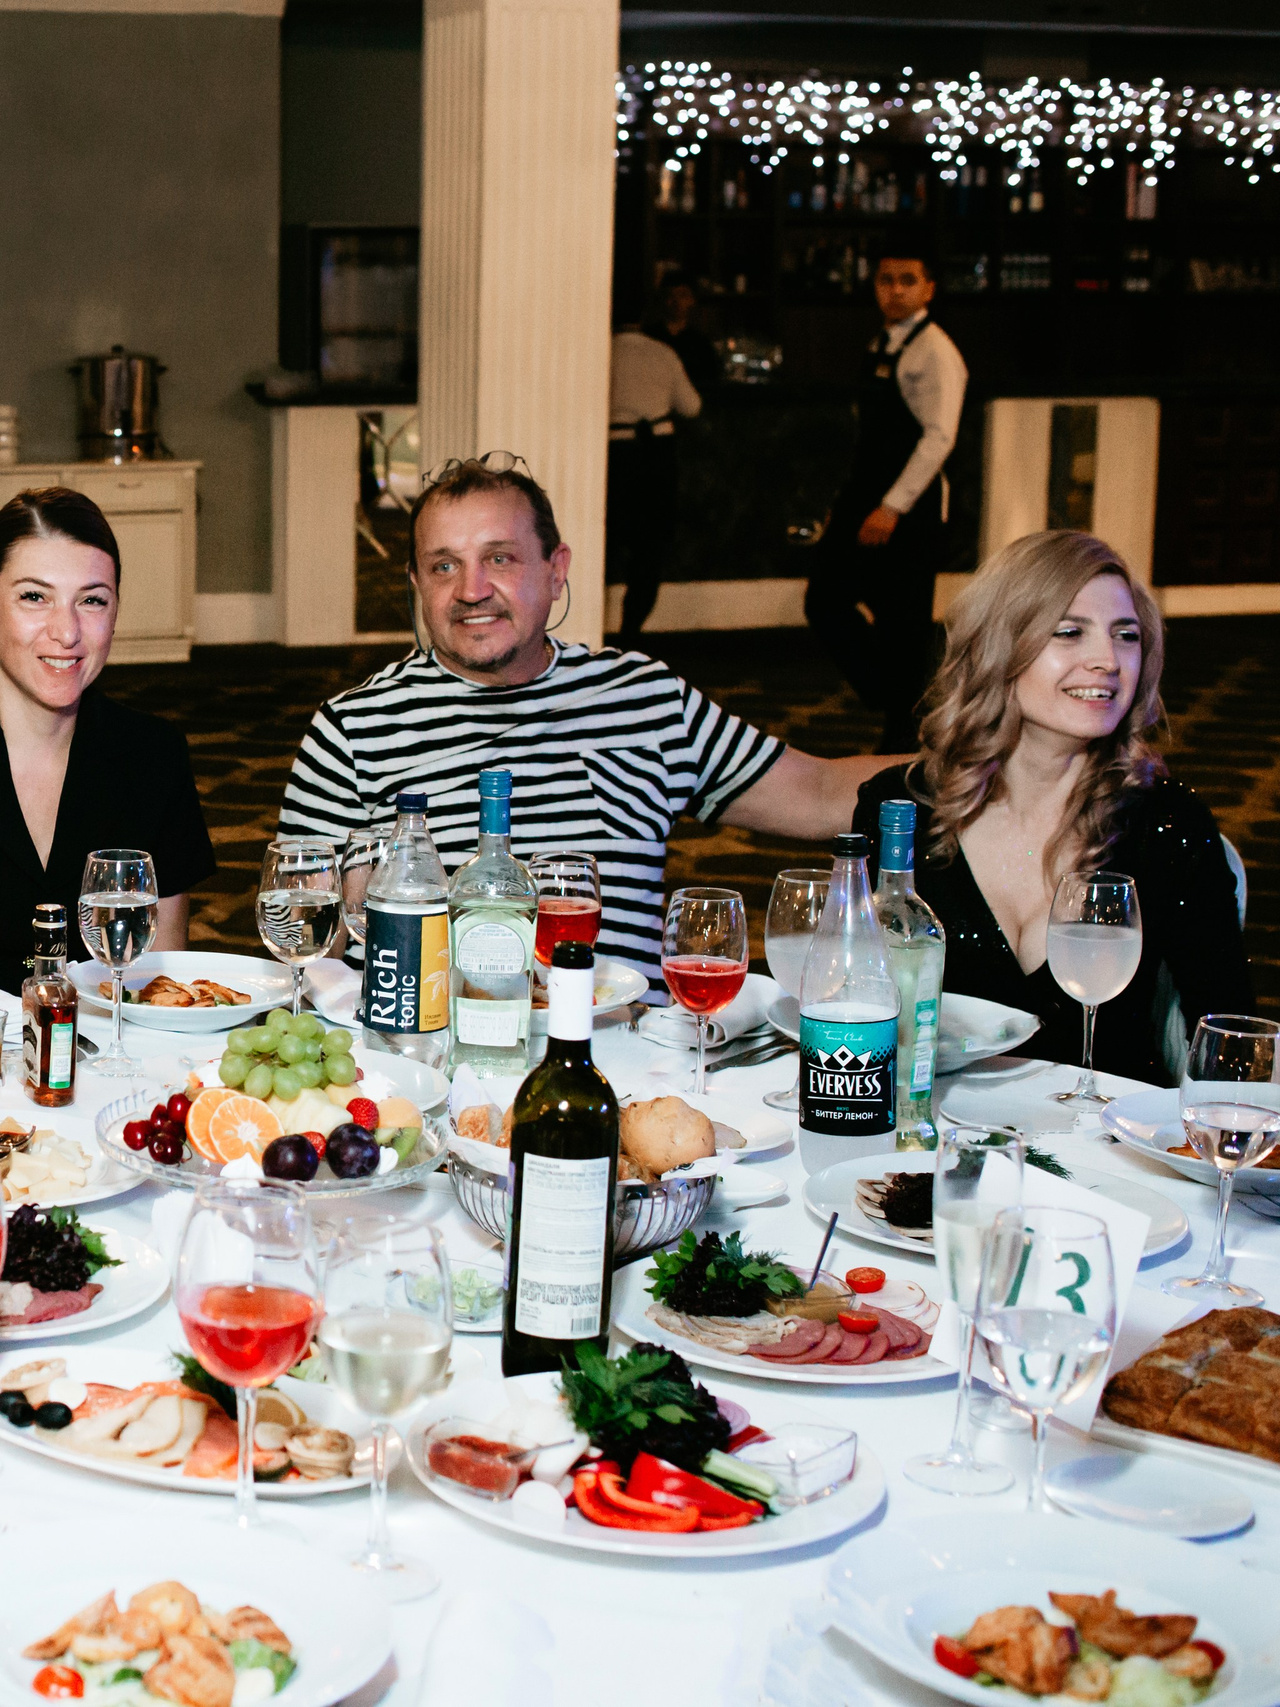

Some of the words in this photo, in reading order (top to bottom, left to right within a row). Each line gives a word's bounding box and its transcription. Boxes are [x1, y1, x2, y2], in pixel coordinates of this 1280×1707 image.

[370, 948, 398, 1028] Rich
[397, 974, 416, 1029] tonic
[809, 1069, 882, 1097] EVERVESS
[815, 1109, 844, 1120] БИТТЕР
[844, 1111, 874, 1121] ЛЕМОН
